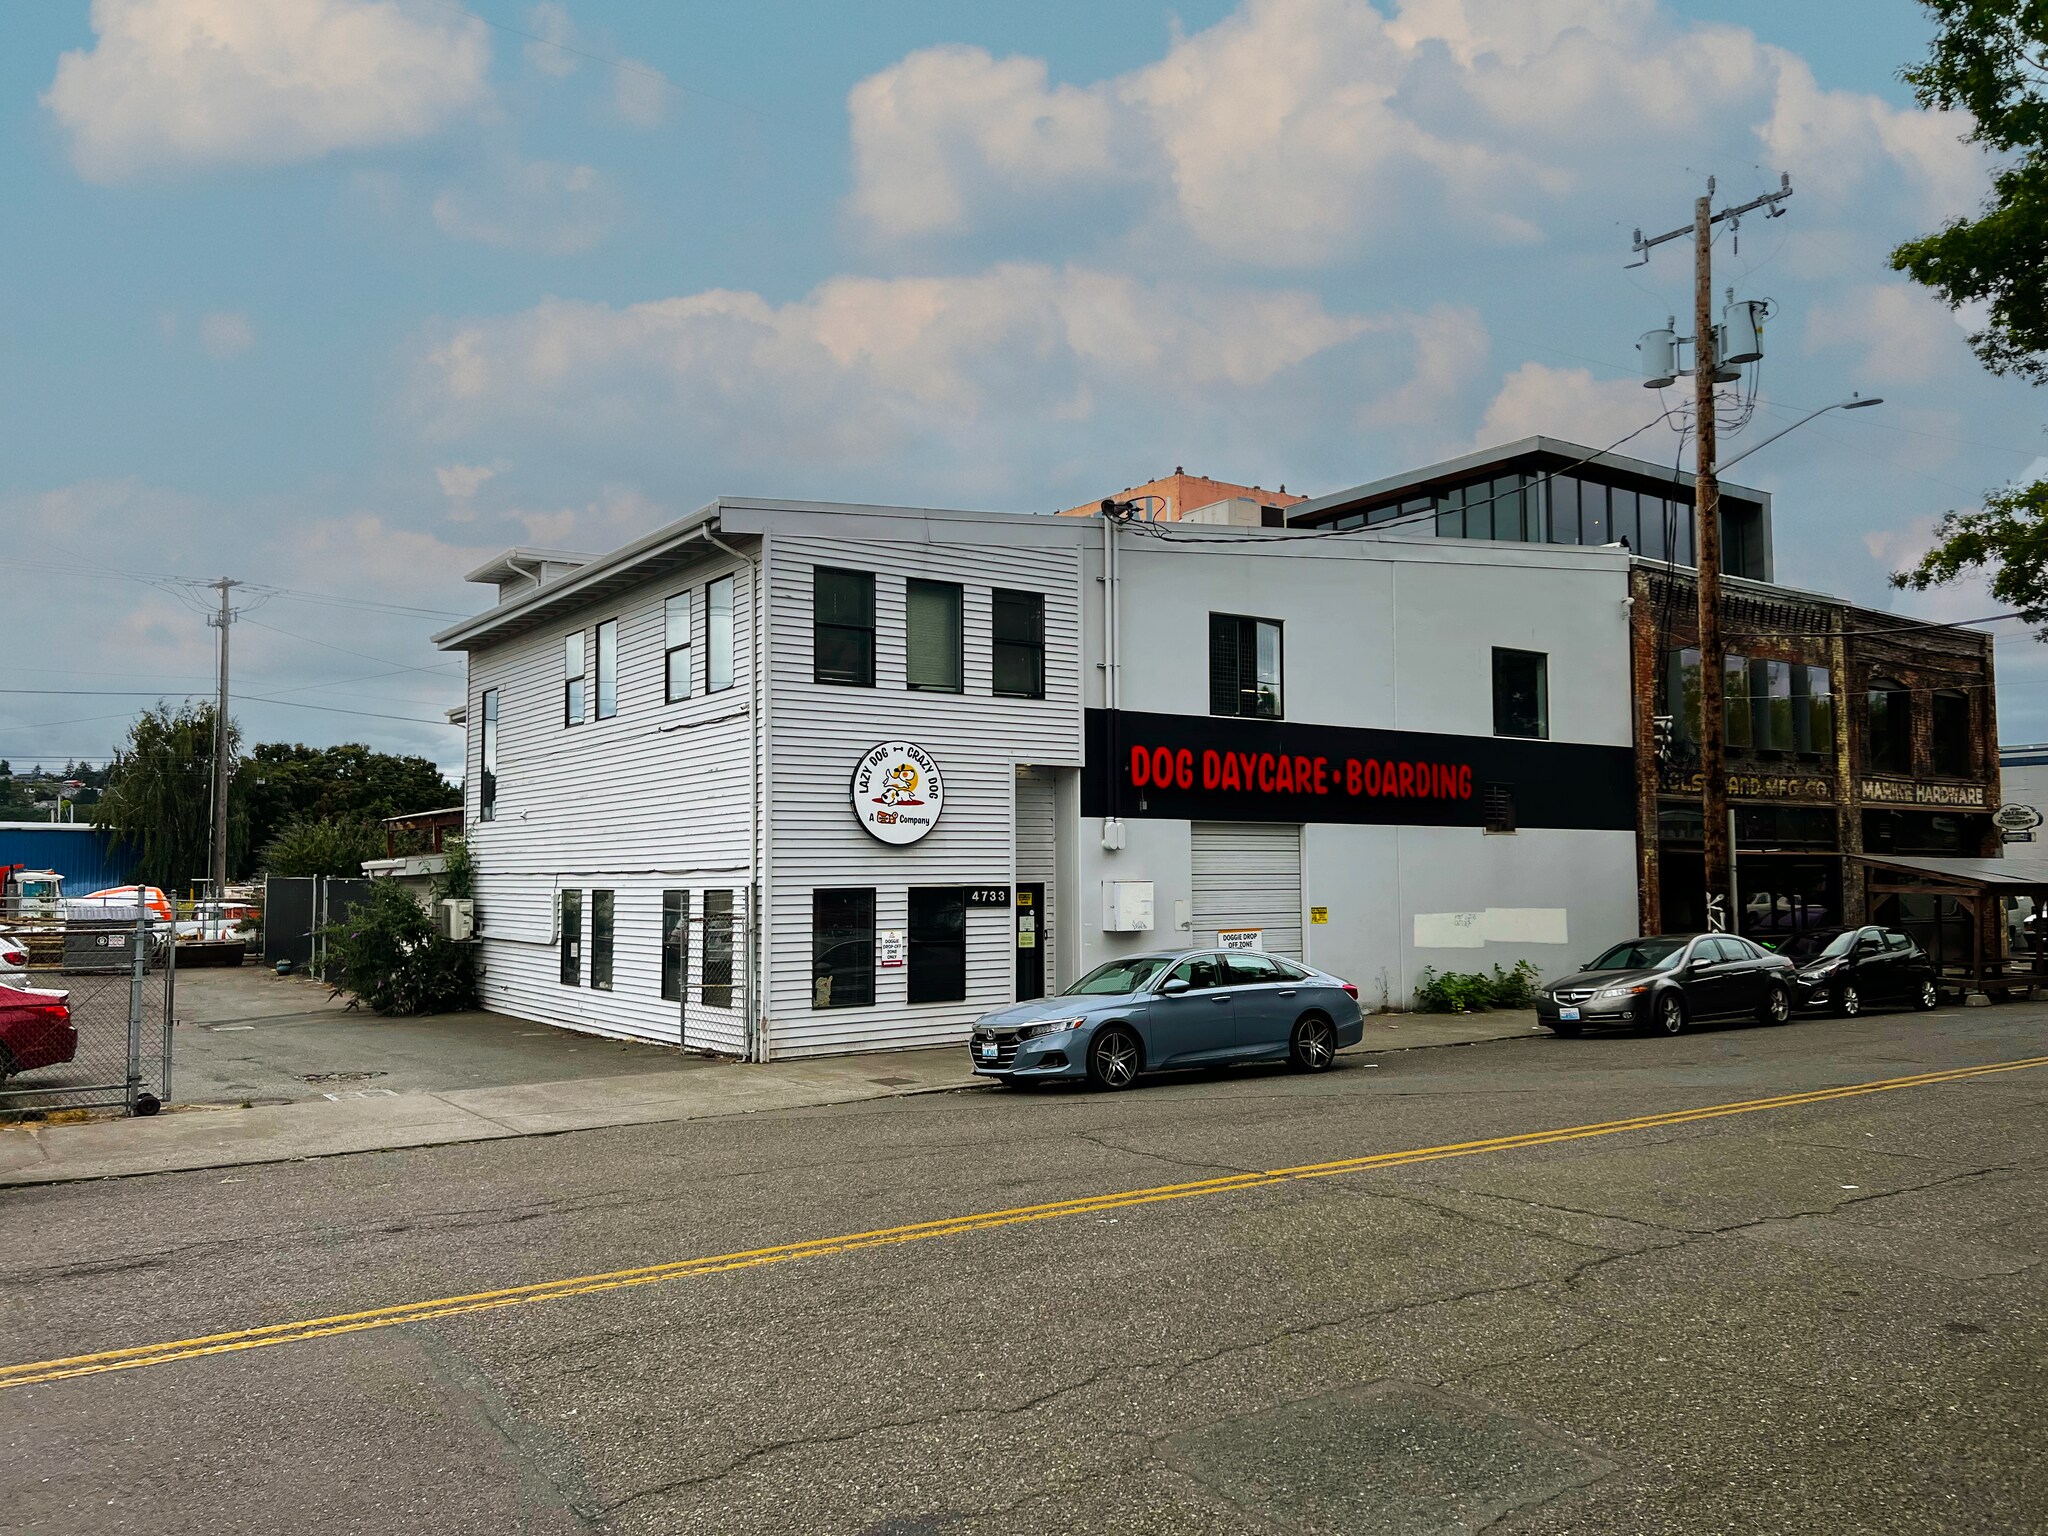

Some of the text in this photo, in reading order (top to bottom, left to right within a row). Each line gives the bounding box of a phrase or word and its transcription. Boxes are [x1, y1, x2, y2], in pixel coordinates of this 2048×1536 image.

[859, 747, 939, 799] LAZY DOG CRAZY DOG
[1131, 745, 1472, 800] DOG DAYCARE BOARDING
[1916, 784, 1983, 804] HARDWARE
[869, 813, 874, 821] A
[899, 814, 930, 826] Company
[971, 891, 1005, 902] 4733
[1243, 932, 1258, 940] DROP
